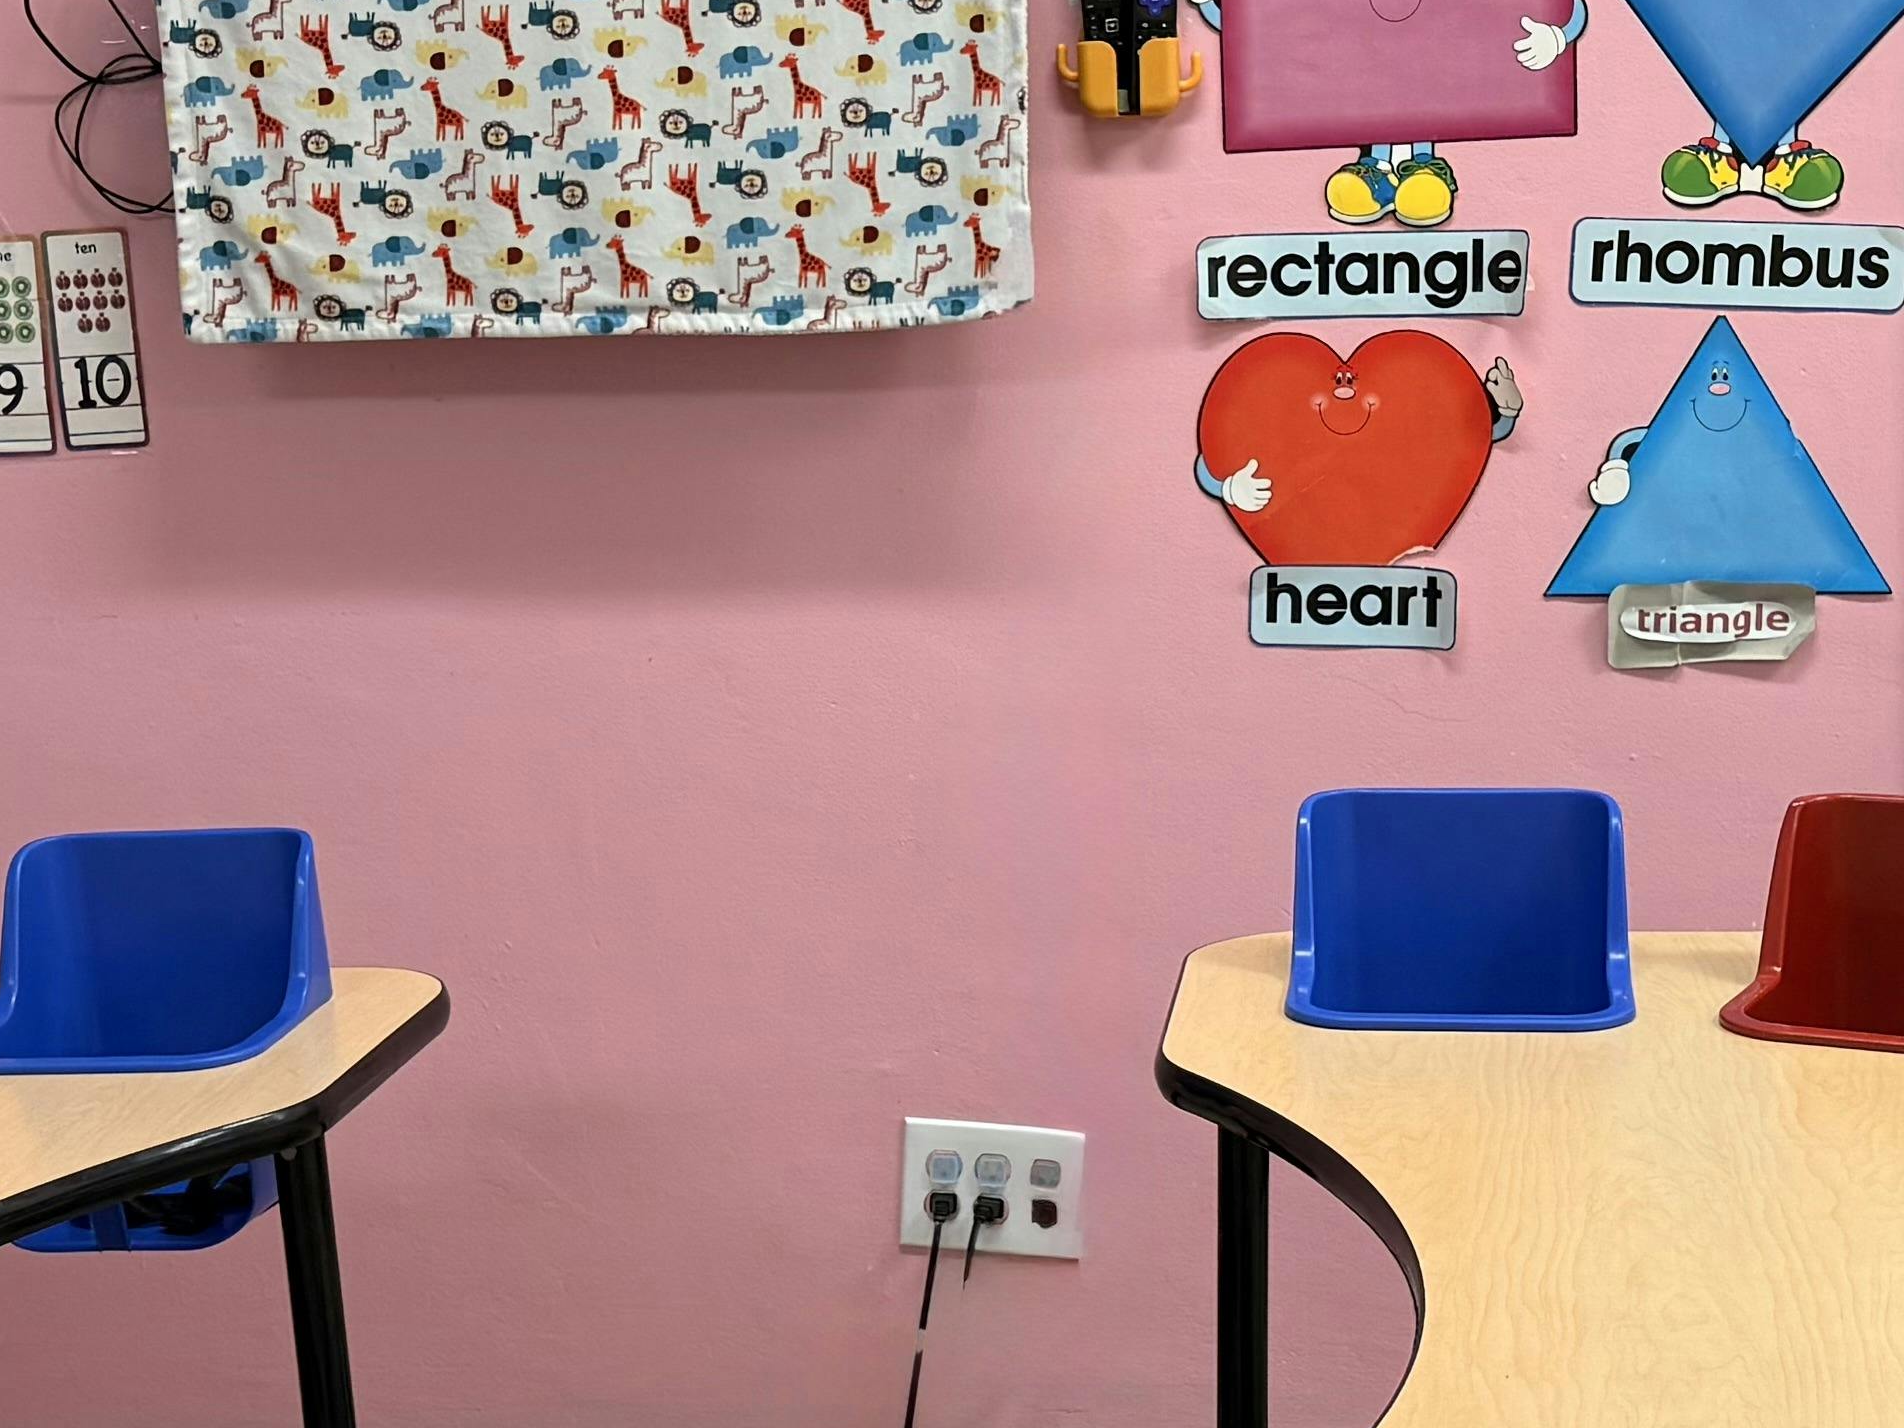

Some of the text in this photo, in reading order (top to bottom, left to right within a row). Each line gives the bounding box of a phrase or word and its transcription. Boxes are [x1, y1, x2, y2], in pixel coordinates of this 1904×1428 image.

[75, 241, 97, 254] ten
[1205, 237, 1523, 308] rectangle
[1589, 229, 1891, 289] rhombus
[76, 354, 131, 409] 10
[1265, 574, 1444, 627] heart
[1635, 603, 1791, 640] triangle
